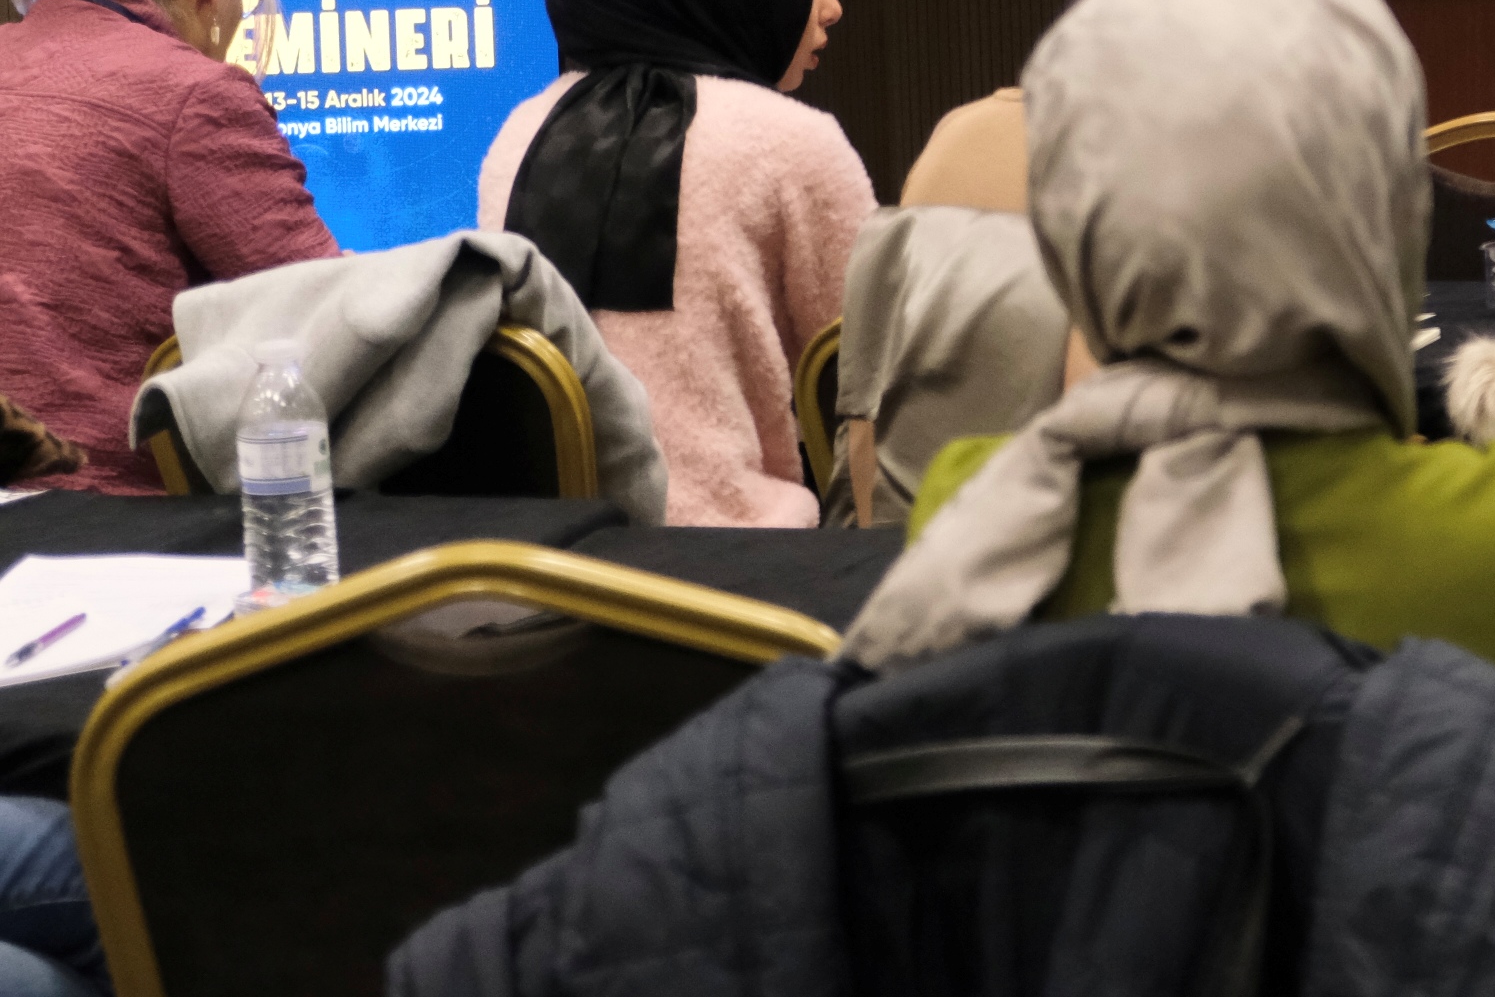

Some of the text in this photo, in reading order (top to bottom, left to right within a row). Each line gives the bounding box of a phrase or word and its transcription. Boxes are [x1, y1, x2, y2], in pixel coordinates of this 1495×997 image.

[324, 88, 387, 109] Aralık
[390, 86, 444, 107] 2024
[278, 113, 443, 139] onya Bilim Merkezi
